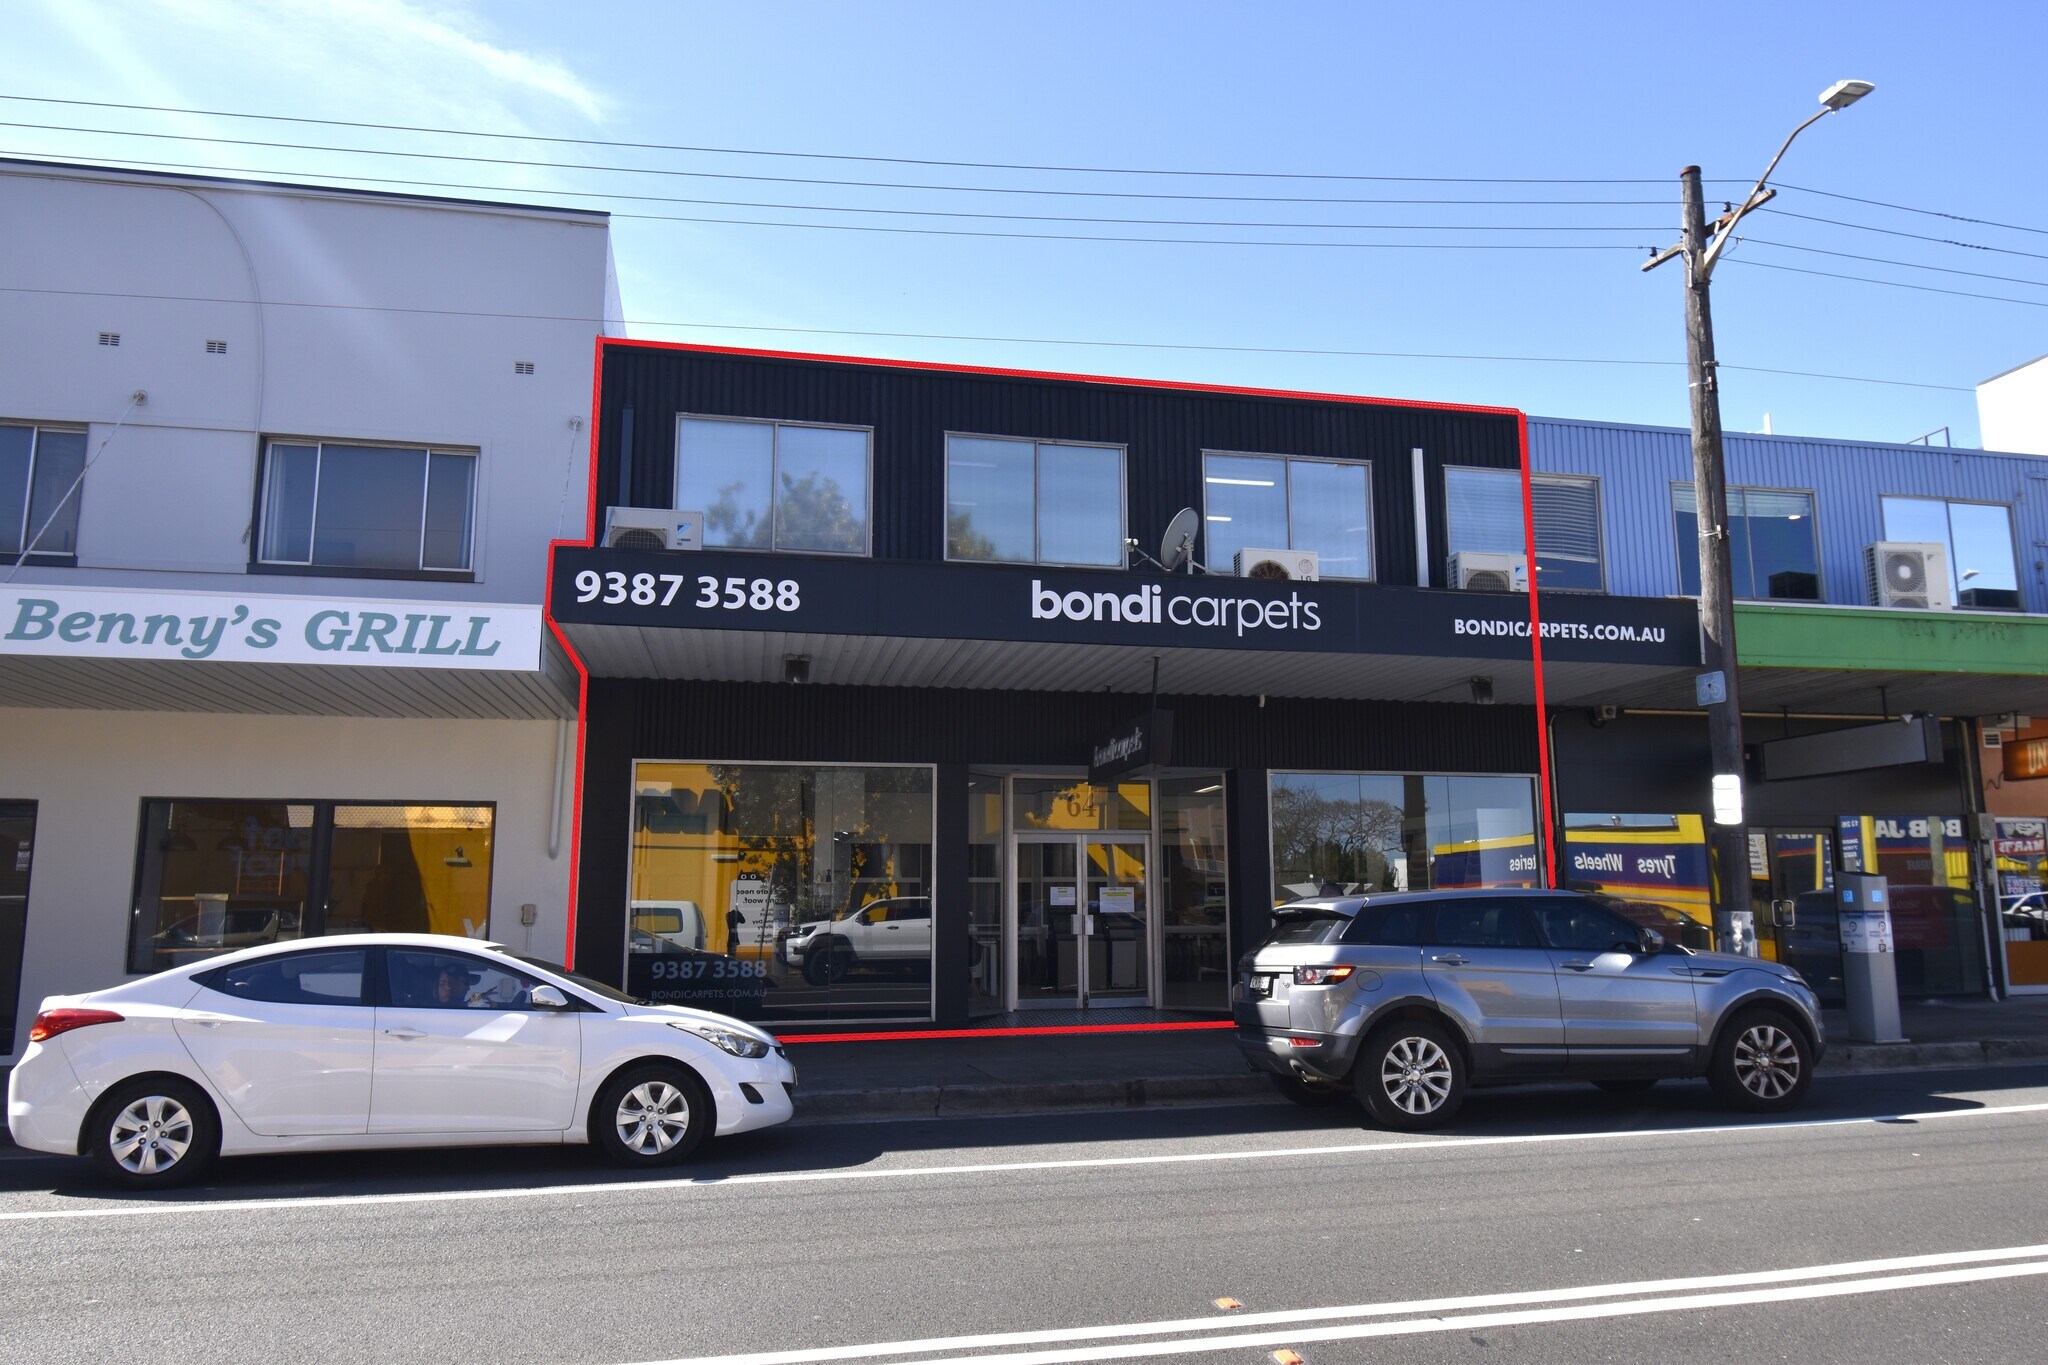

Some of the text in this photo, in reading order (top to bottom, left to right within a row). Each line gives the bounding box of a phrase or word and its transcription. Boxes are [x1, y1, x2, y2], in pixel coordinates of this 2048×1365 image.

[576, 570, 801, 612] 9387 3588
[3, 598, 501, 659] Benny's GRILL
[1067, 792, 1097, 817] 64
[651, 959, 767, 980] 9387 3588
[651, 988, 767, 1000] BONDICARPETS.COM.AU
